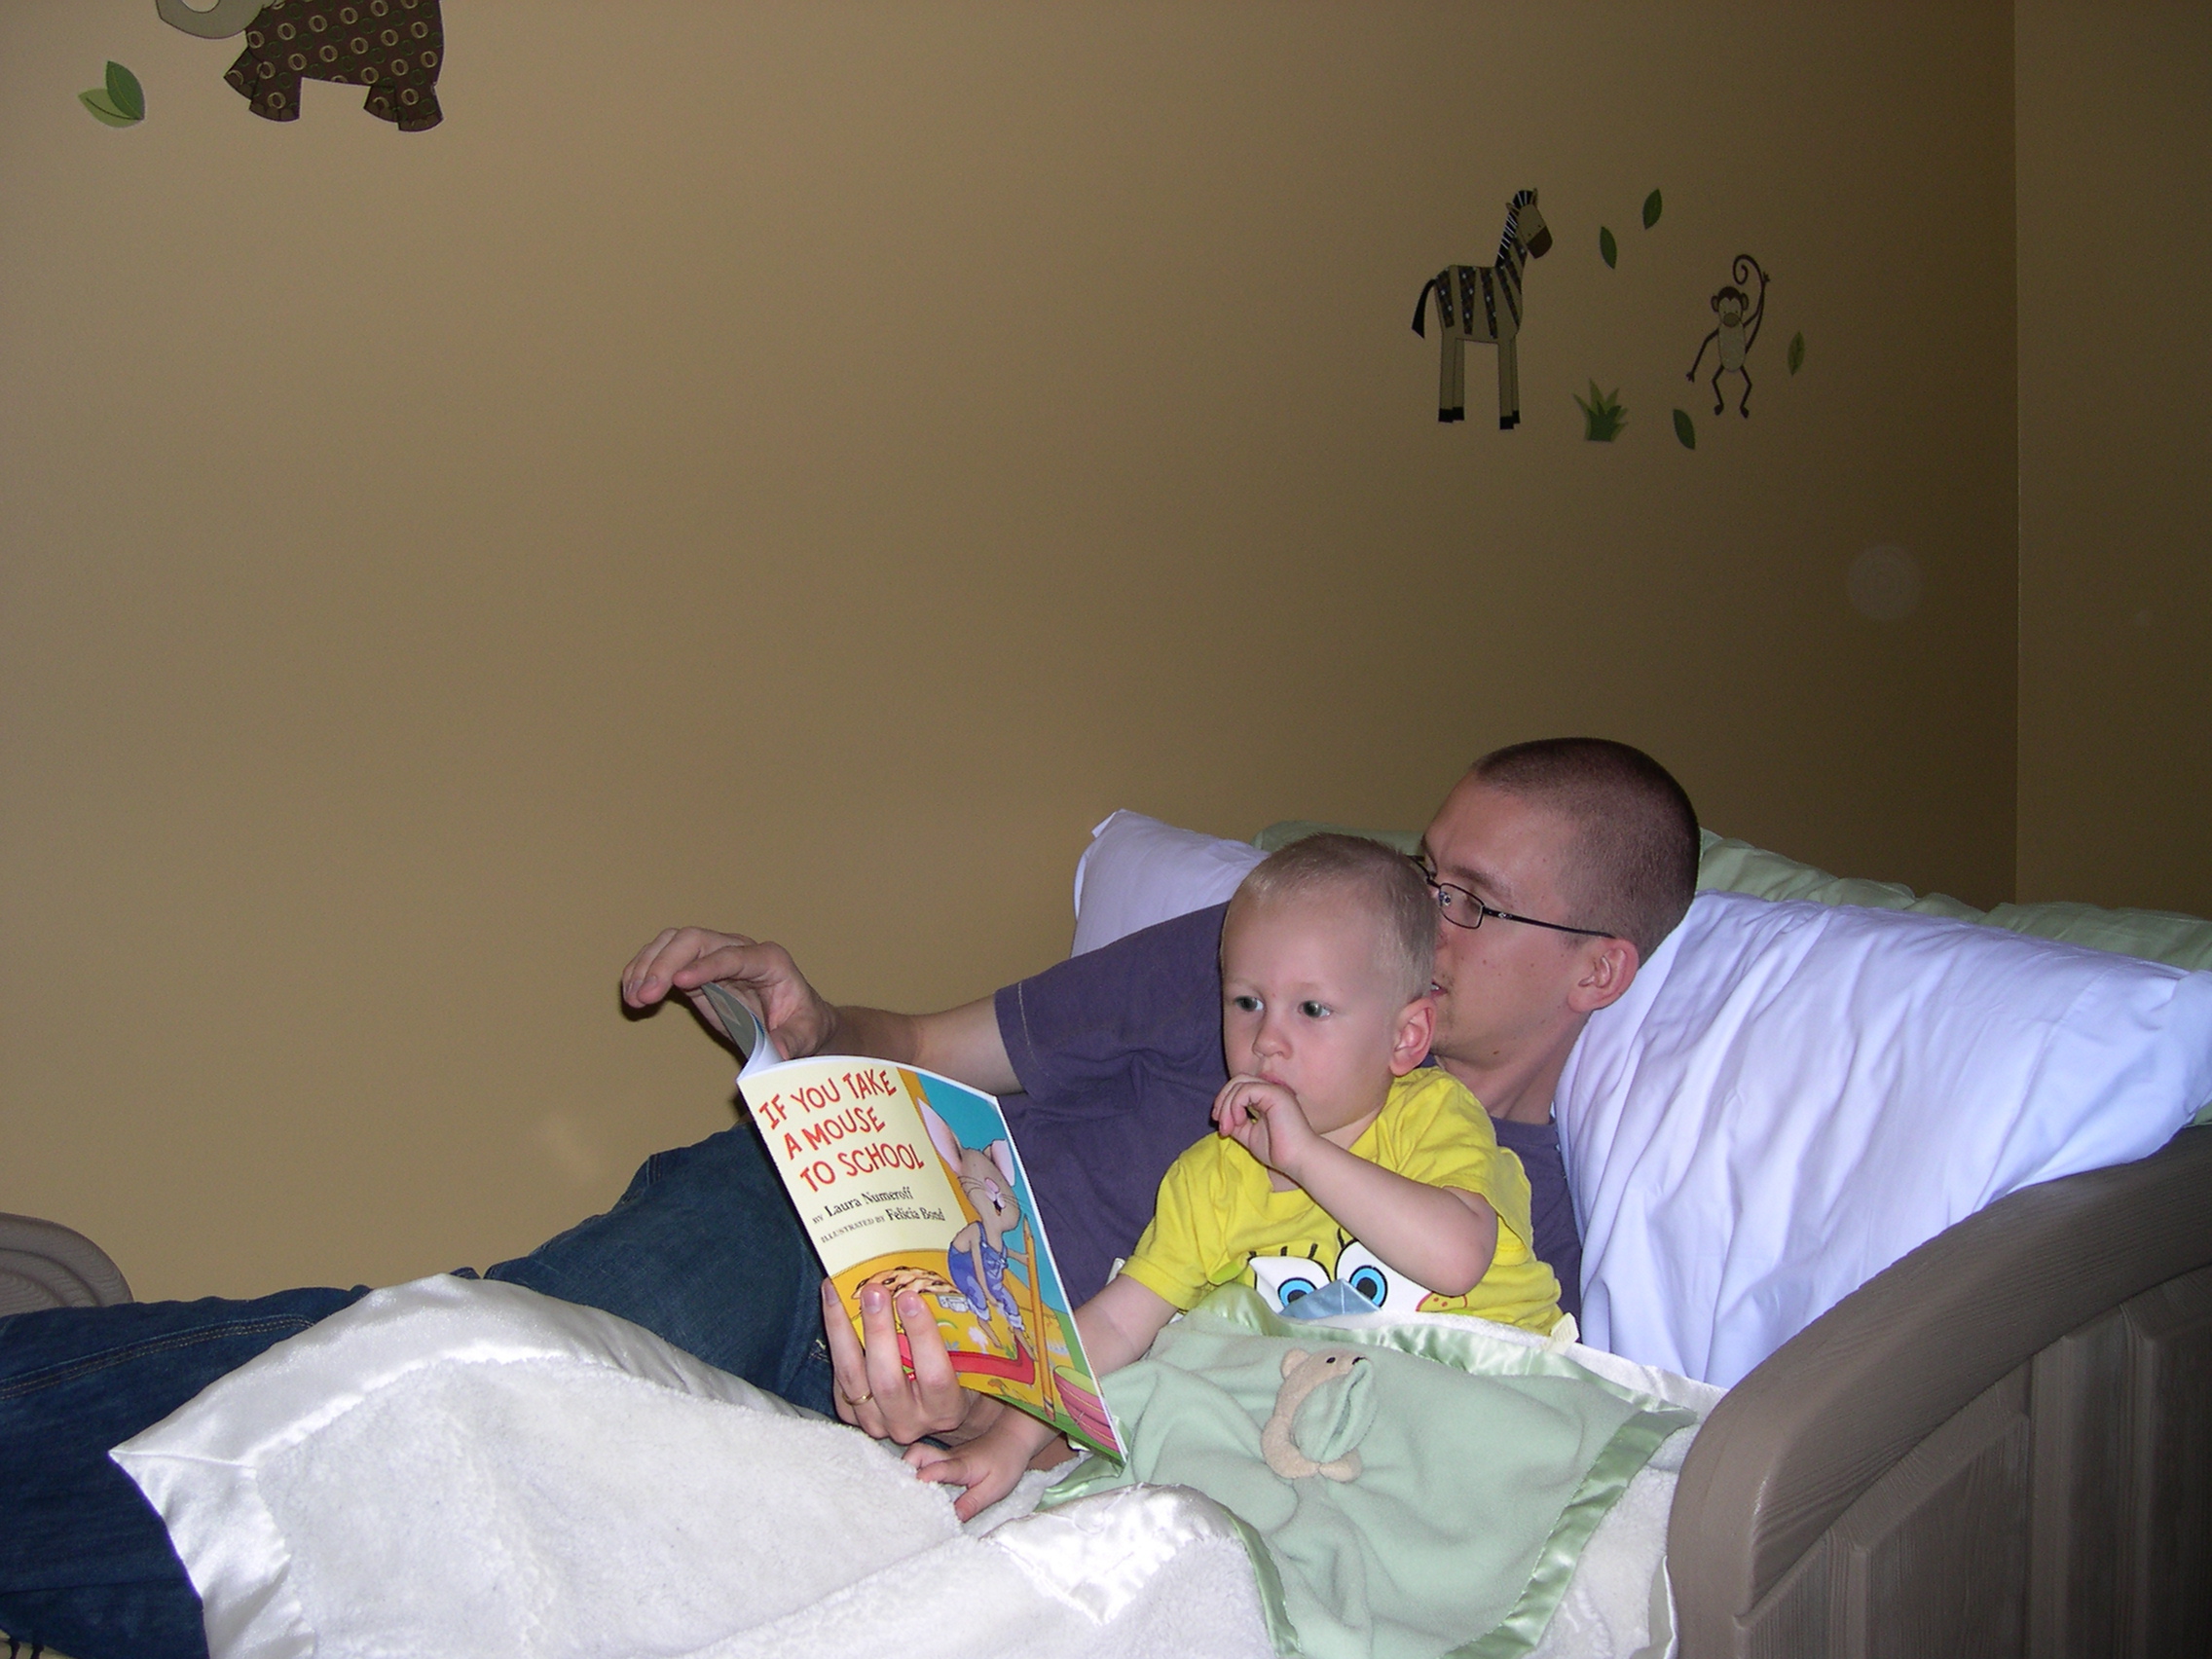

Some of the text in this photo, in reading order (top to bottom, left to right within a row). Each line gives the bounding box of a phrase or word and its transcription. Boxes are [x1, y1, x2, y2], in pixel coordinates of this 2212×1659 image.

[758, 1068, 897, 1129] IF YOU TAKE
[784, 1106, 886, 1161] A MOUSE
[799, 1143, 924, 1193] TO SCHOOL
[812, 1186, 914, 1224] BY Laura Numeroff
[821, 1218, 874, 1243] ILLUSTRATED
[885, 1207, 920, 1221] Felicia
[919, 1206, 945, 1221] Bond
